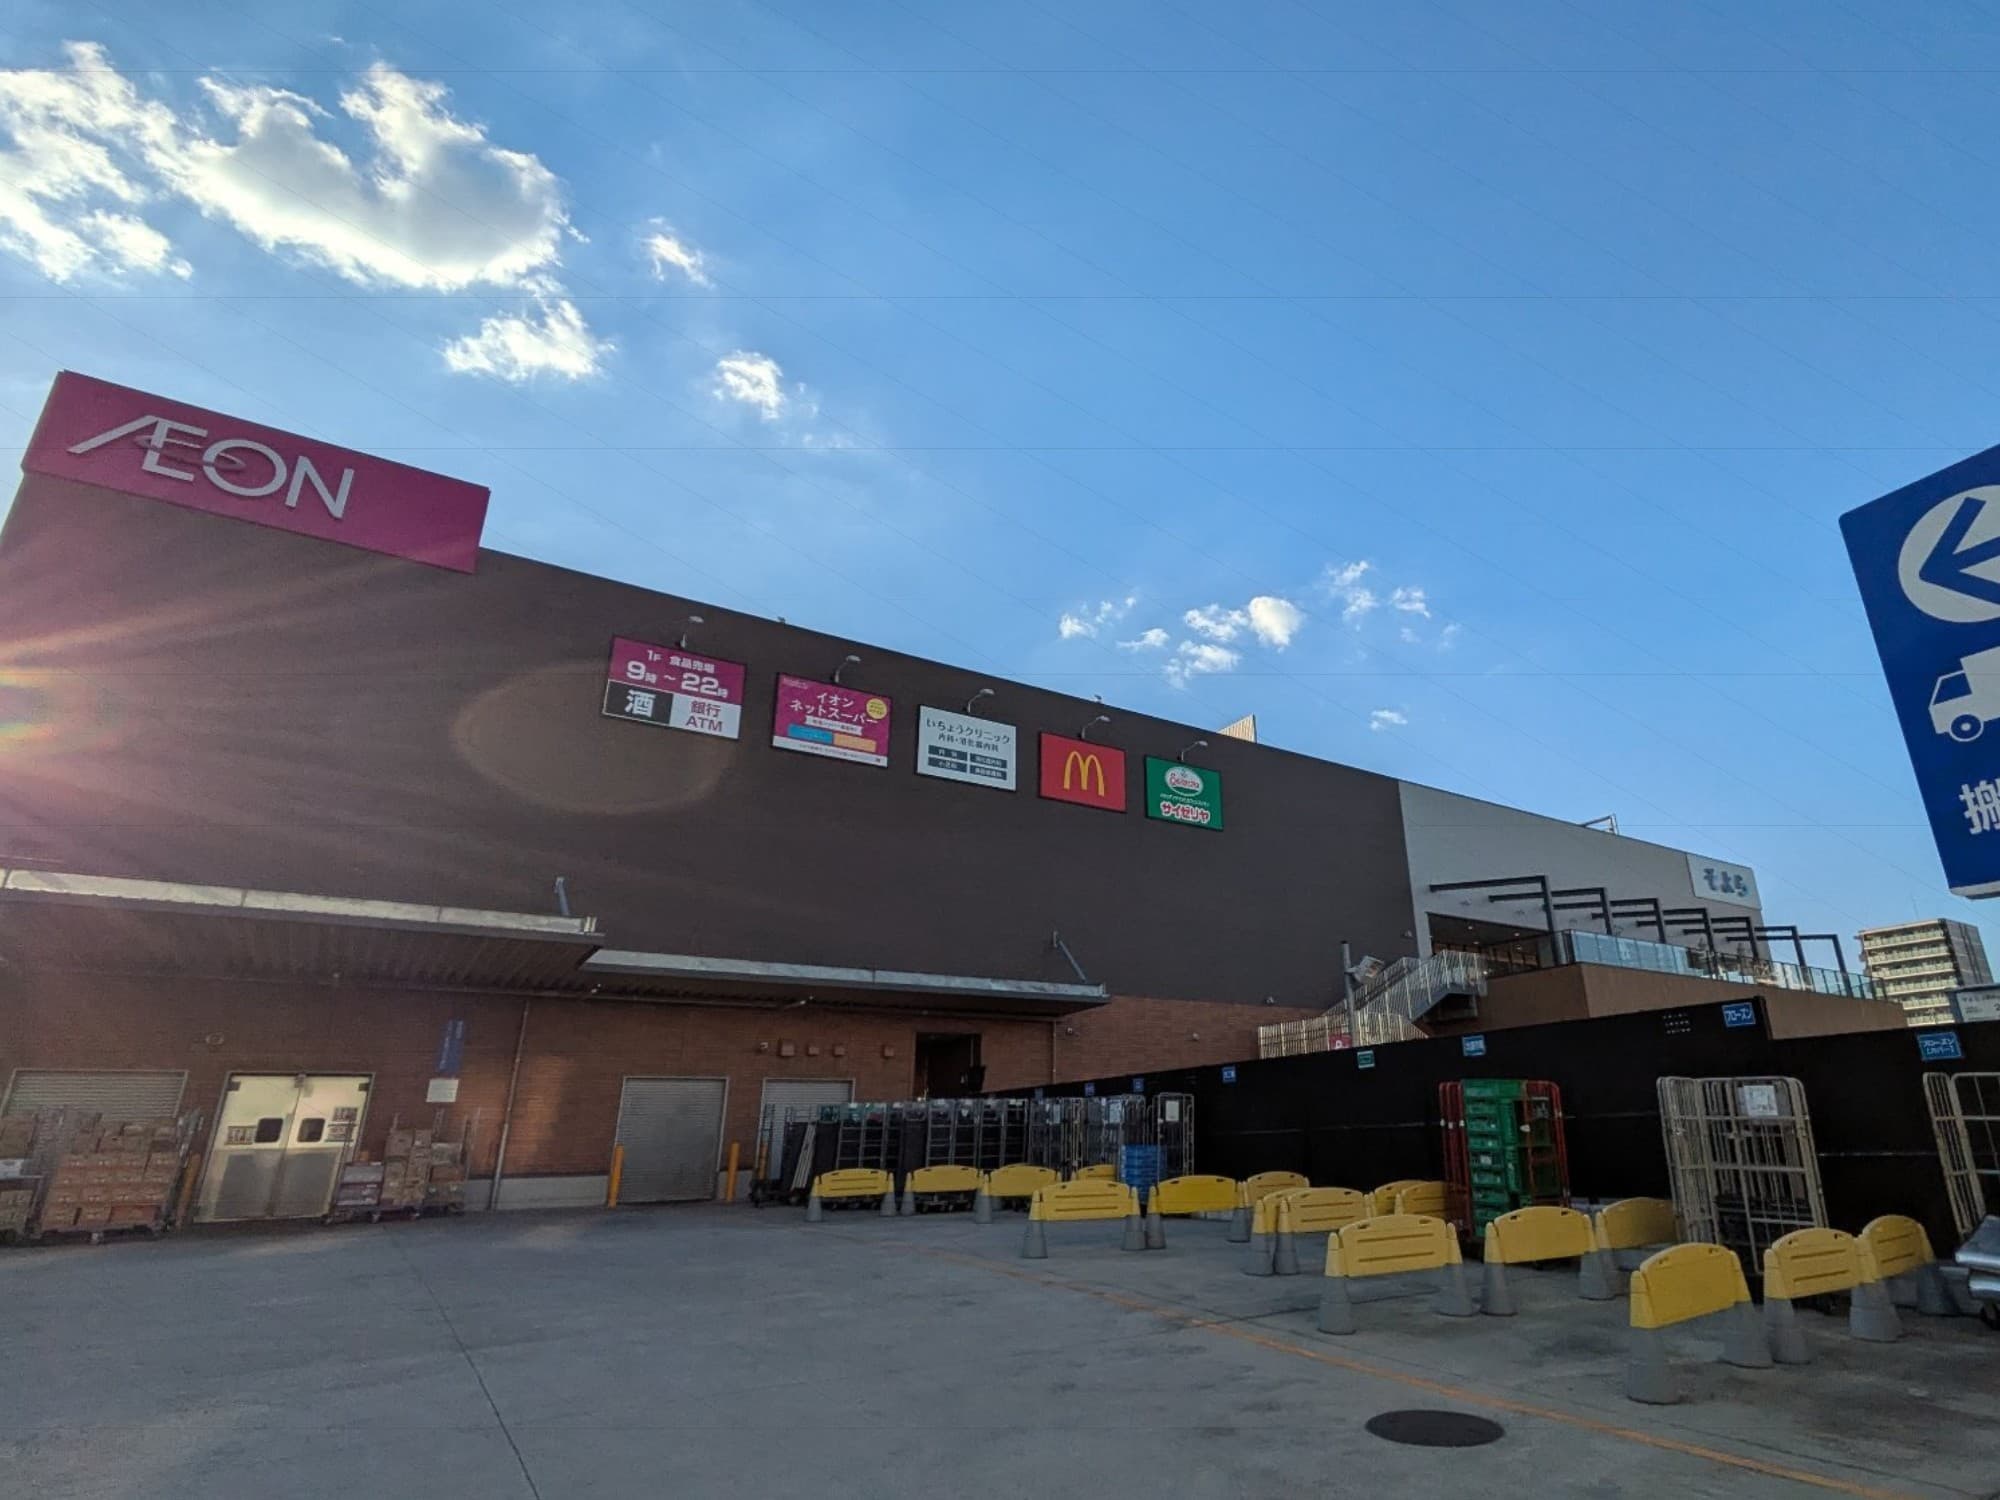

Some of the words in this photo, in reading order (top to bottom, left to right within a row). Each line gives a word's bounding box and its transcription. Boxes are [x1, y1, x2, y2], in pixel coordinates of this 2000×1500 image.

[669, 655, 715, 673] 食品売場
[624, 689, 656, 718] 酒
[690, 701, 721, 718] 銀行
[817, 692, 854, 707] イオン
[790, 699, 878, 724] ネットスーパー
[685, 716, 723, 733] ATM
[926, 717, 1010, 744] いちょうクリニック
[1160, 801, 1210, 823] サイゼリヤ
